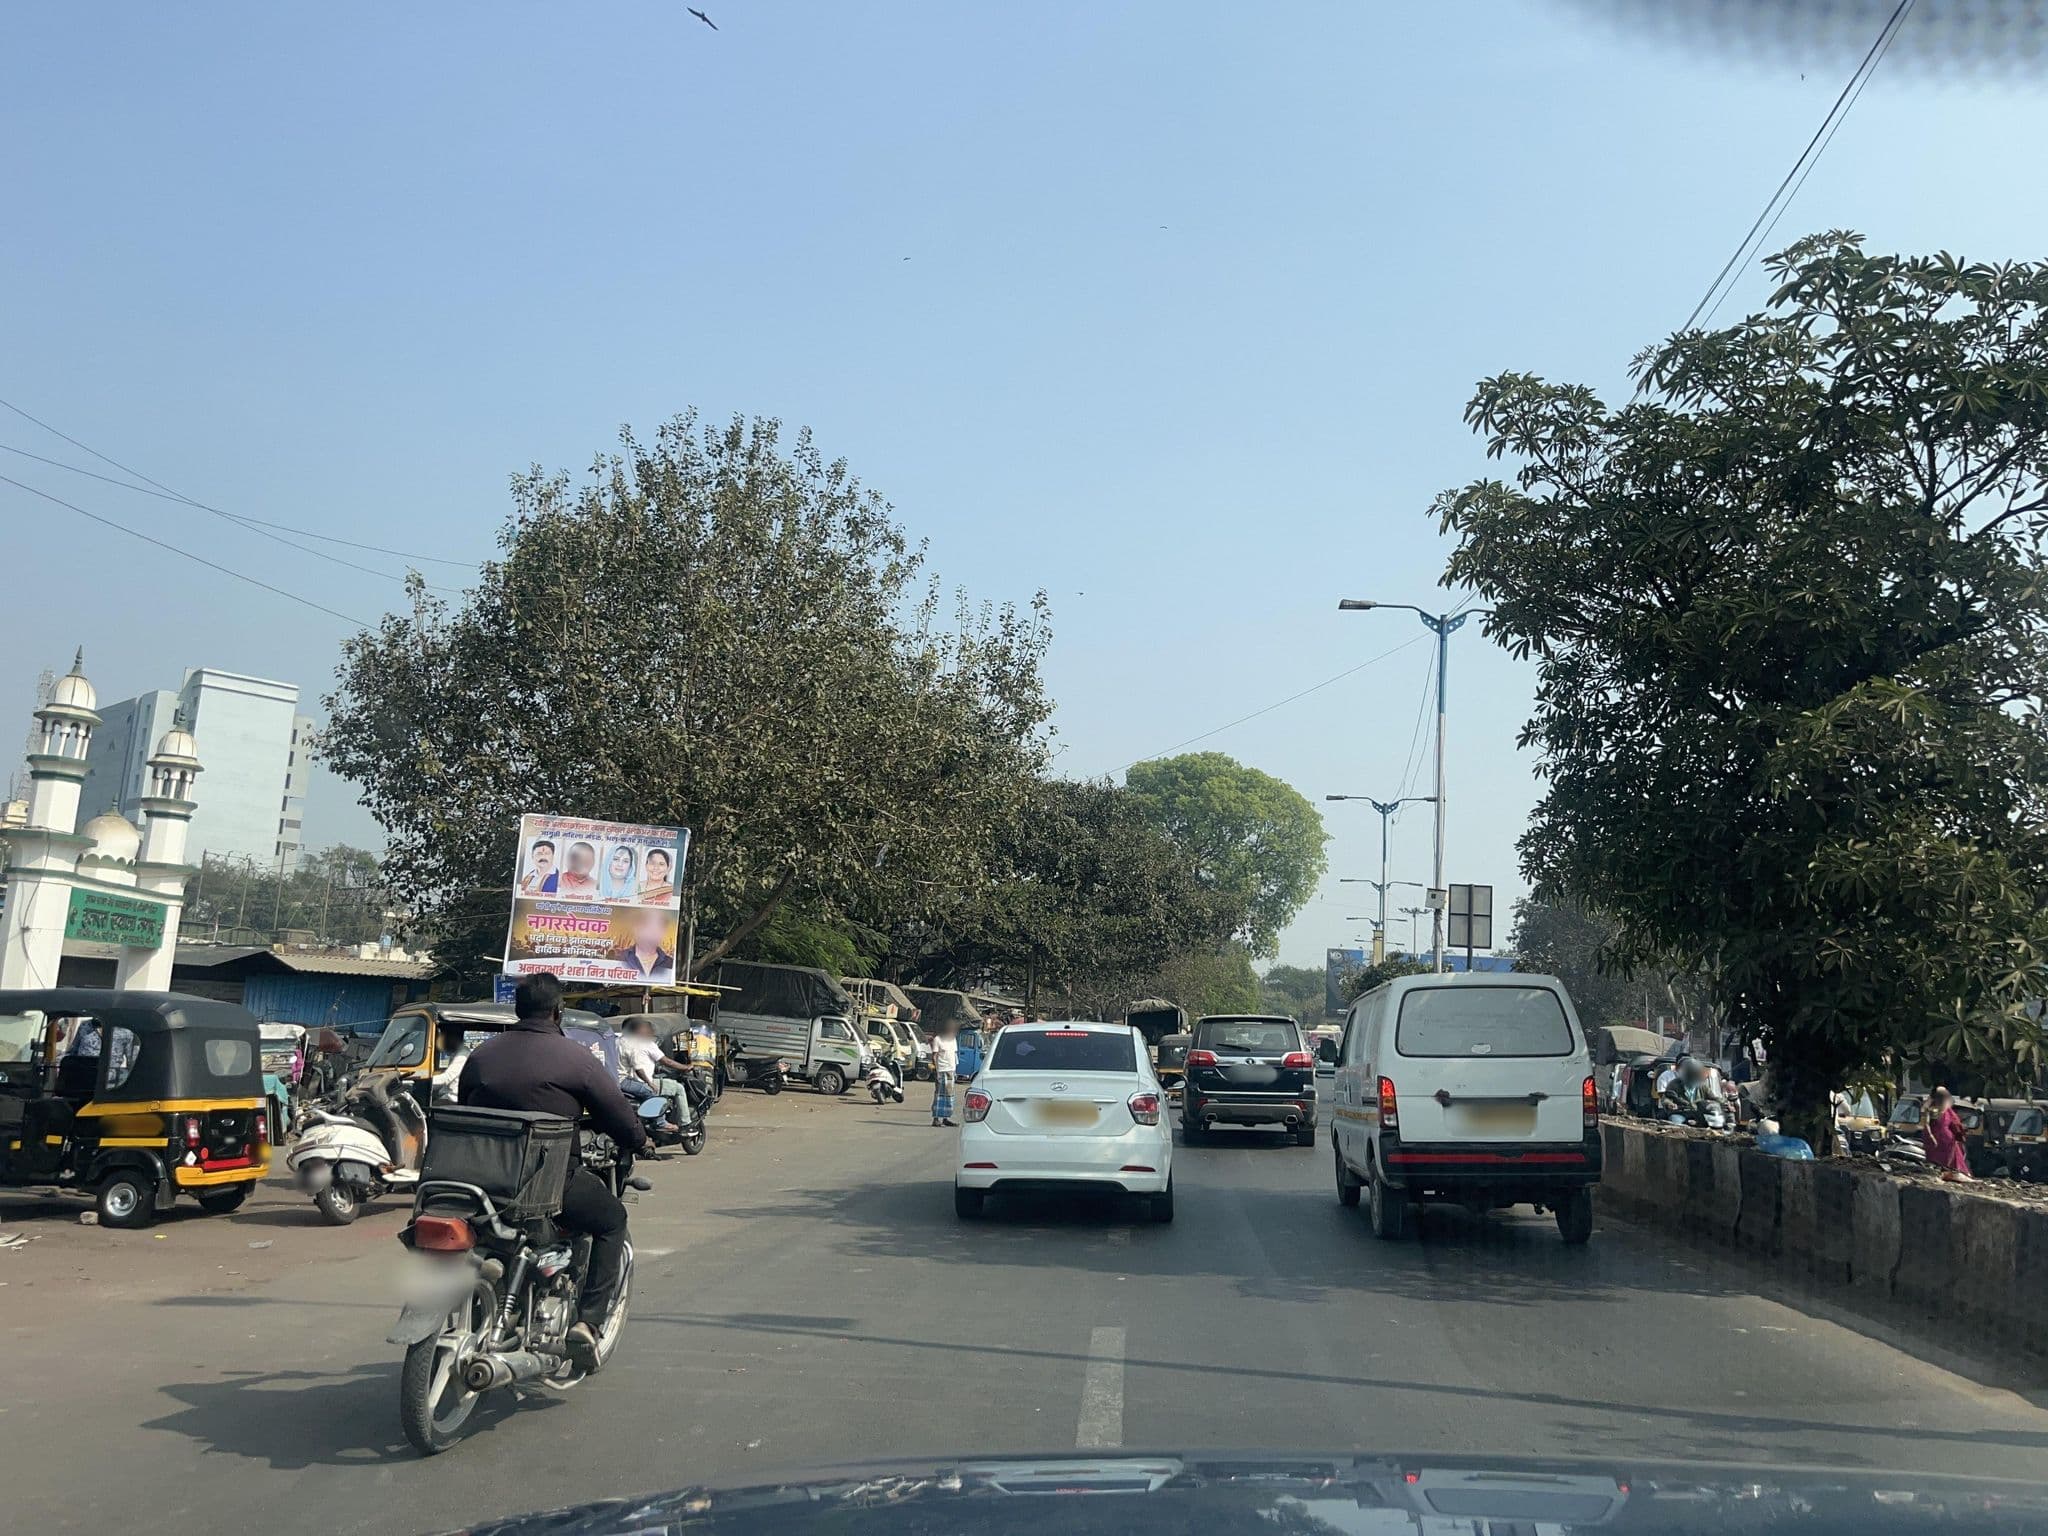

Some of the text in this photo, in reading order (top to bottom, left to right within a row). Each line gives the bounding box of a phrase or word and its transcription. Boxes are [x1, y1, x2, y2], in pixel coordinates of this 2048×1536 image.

[527, 913, 609, 934] नगरसेवक
[567, 967, 585, 977] शहा
[588, 966, 605, 978] मित्र
[608, 968, 639, 980] परिवार
